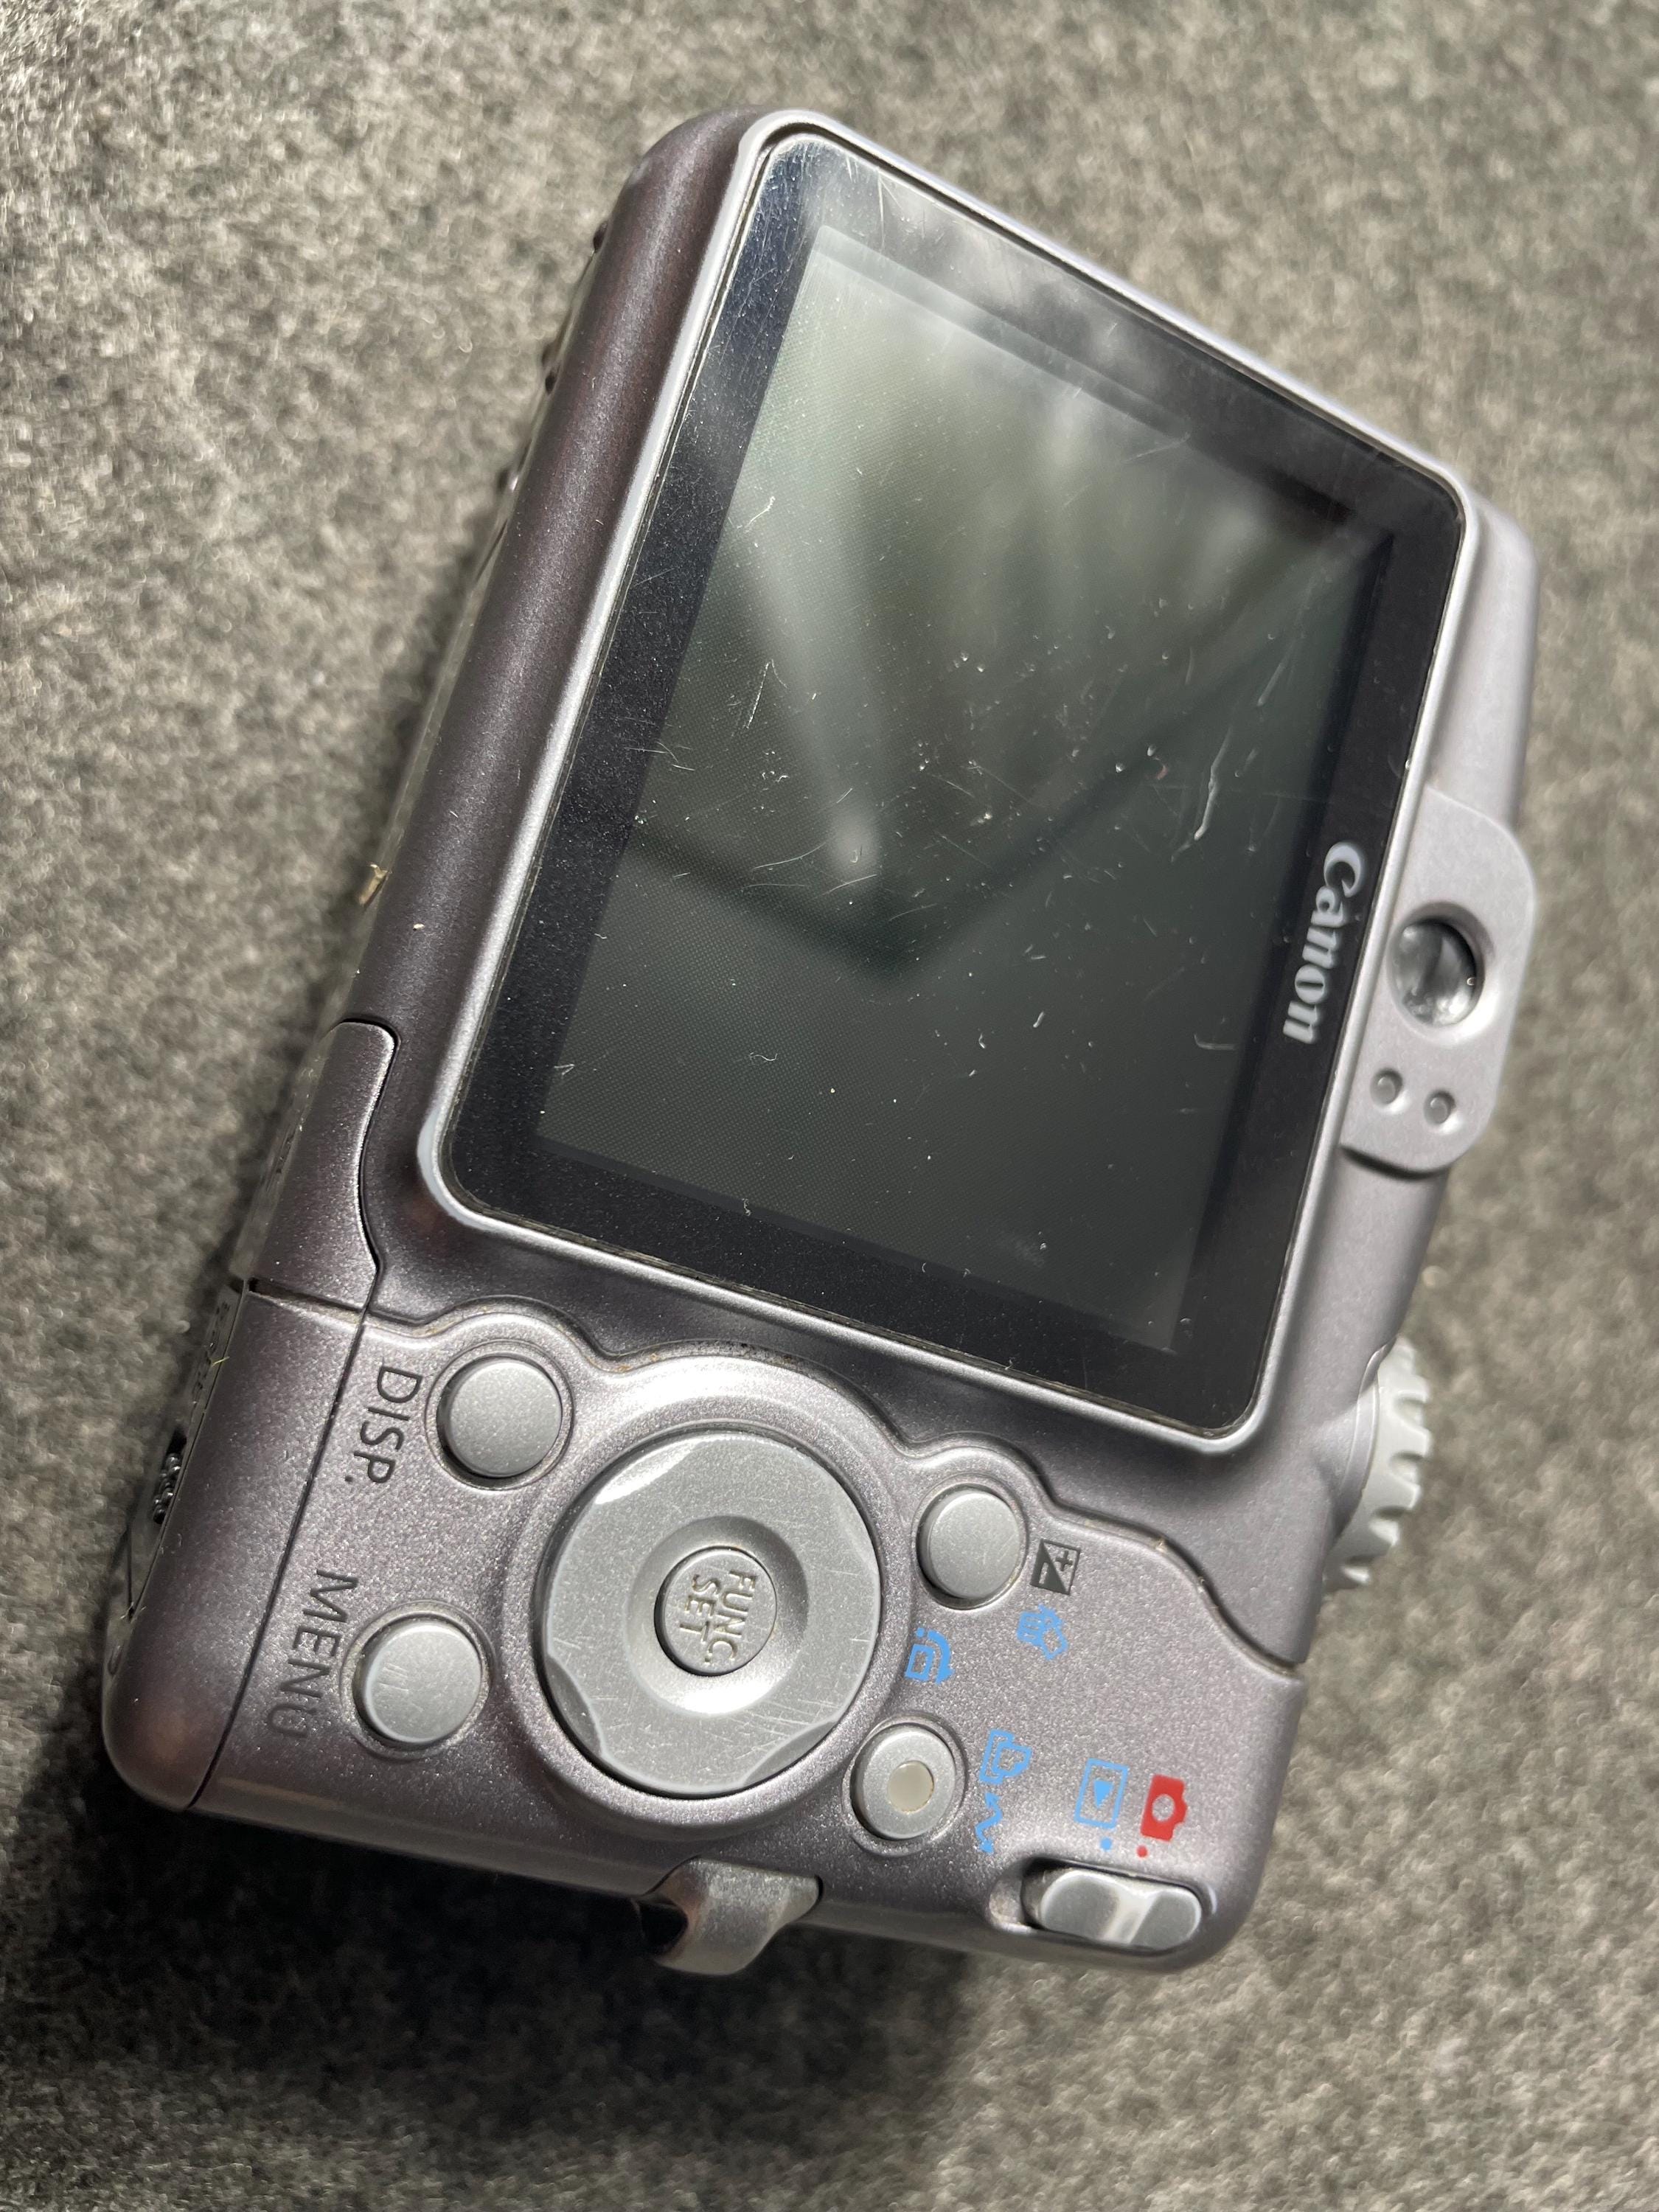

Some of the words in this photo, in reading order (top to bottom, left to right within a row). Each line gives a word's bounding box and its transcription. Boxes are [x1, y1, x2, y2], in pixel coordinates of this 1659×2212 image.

[1282, 841, 1364, 1044] Canon
[346, 1366, 423, 1484] DISP.
[267, 1569, 359, 1739] MENU
[679, 1573, 720, 1645] SET
[705, 1570, 758, 1664] FUNC.
